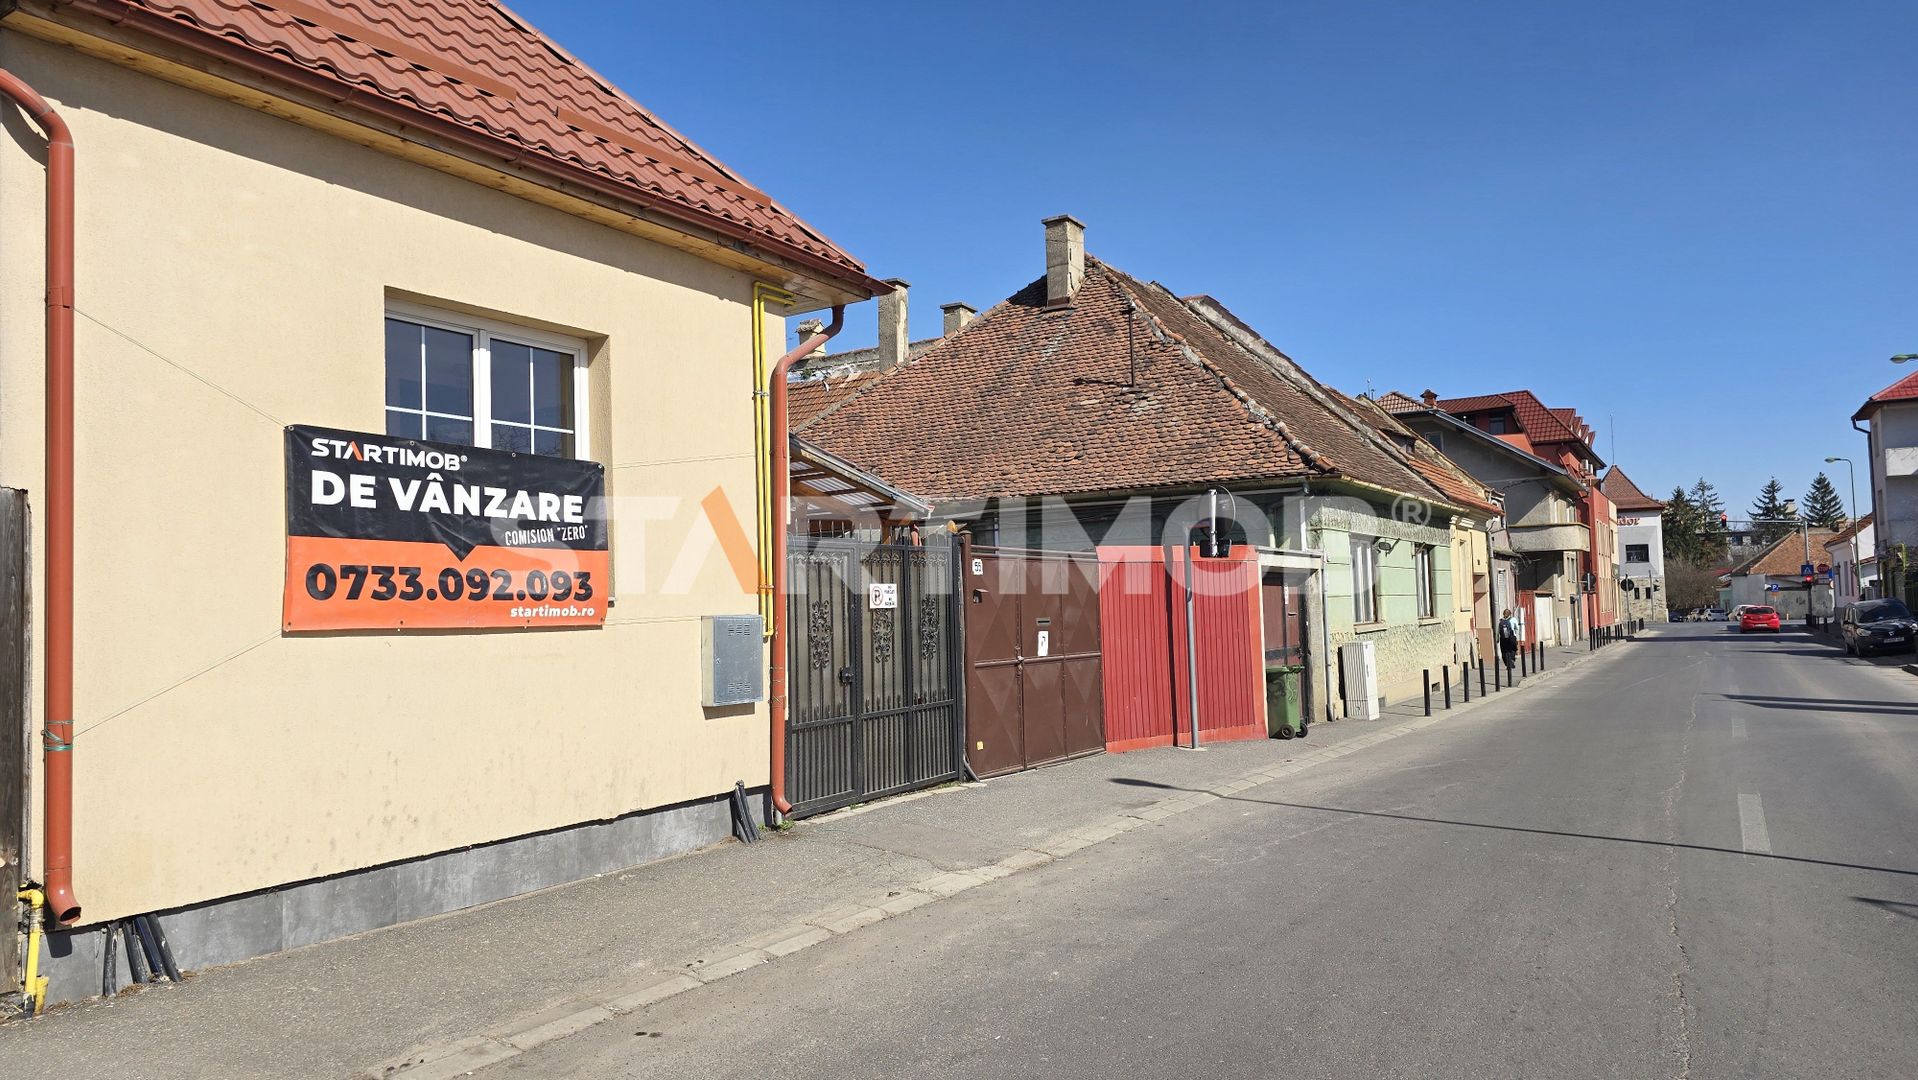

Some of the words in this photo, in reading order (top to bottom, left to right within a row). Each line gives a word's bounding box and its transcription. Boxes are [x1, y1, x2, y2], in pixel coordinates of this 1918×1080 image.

[311, 469, 377, 509] DE
[388, 472, 583, 524] VÂNZARE
[505, 528, 554, 546] COMISION
[557, 525, 588, 541] "ZERO"
[305, 563, 594, 601] 0733.092.093
[510, 604, 595, 618] startimob.ro
